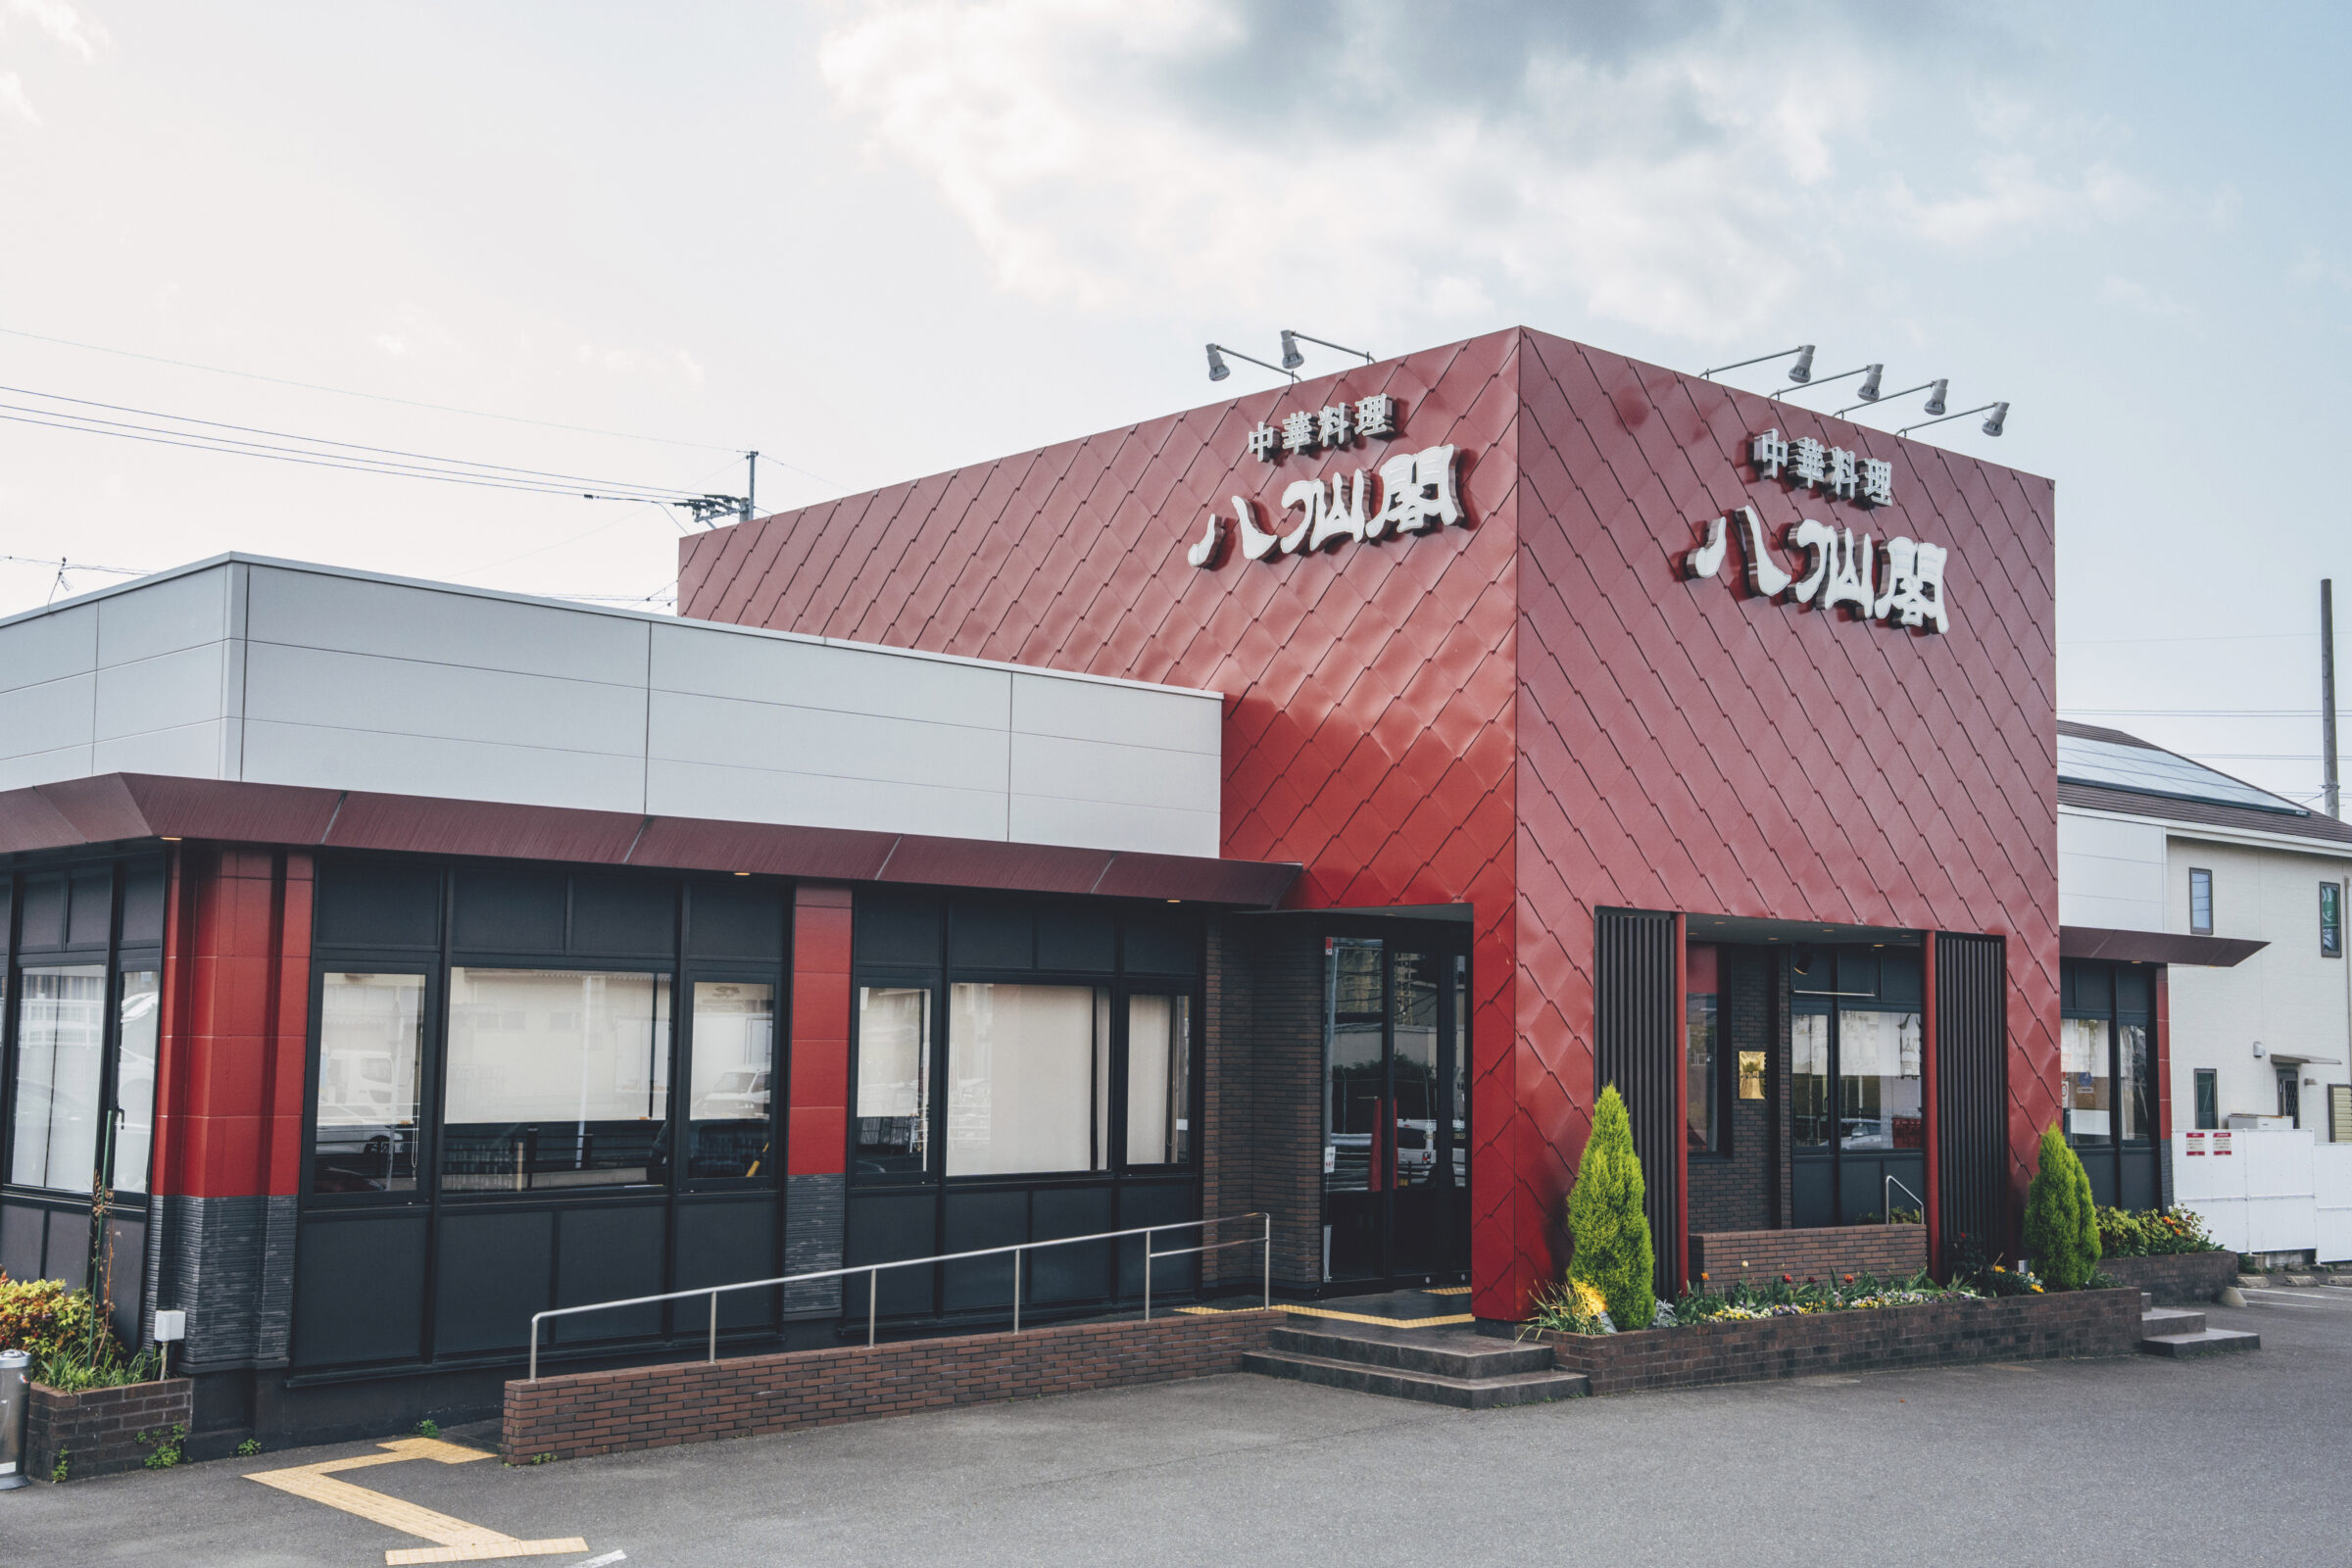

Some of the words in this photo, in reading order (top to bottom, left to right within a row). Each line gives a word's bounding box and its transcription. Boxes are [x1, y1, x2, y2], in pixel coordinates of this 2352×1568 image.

[1249, 393, 1391, 463] 中華料理
[1759, 428, 1892, 507] 中華料理
[1188, 444, 1458, 567] 八仙閣
[1692, 505, 1950, 635] 八仙閣
